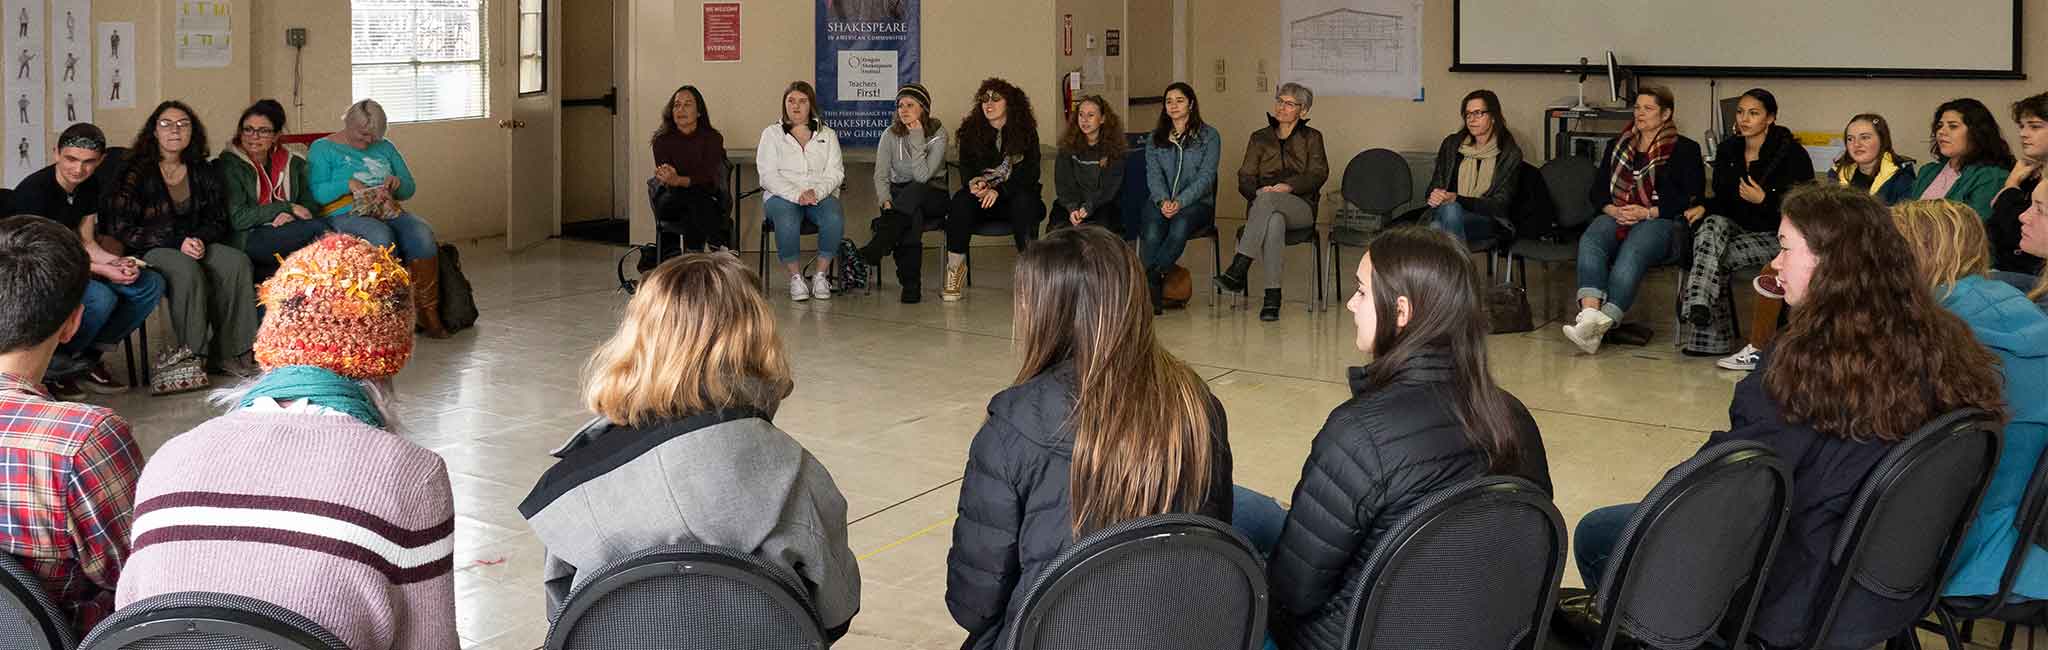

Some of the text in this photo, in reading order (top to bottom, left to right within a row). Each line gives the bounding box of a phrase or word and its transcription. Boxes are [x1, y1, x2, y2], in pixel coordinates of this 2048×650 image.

[827, 22, 908, 33] SHAKESPEARE
[856, 88, 880, 97] First!
[824, 119, 889, 128] SHAKESPEARE
